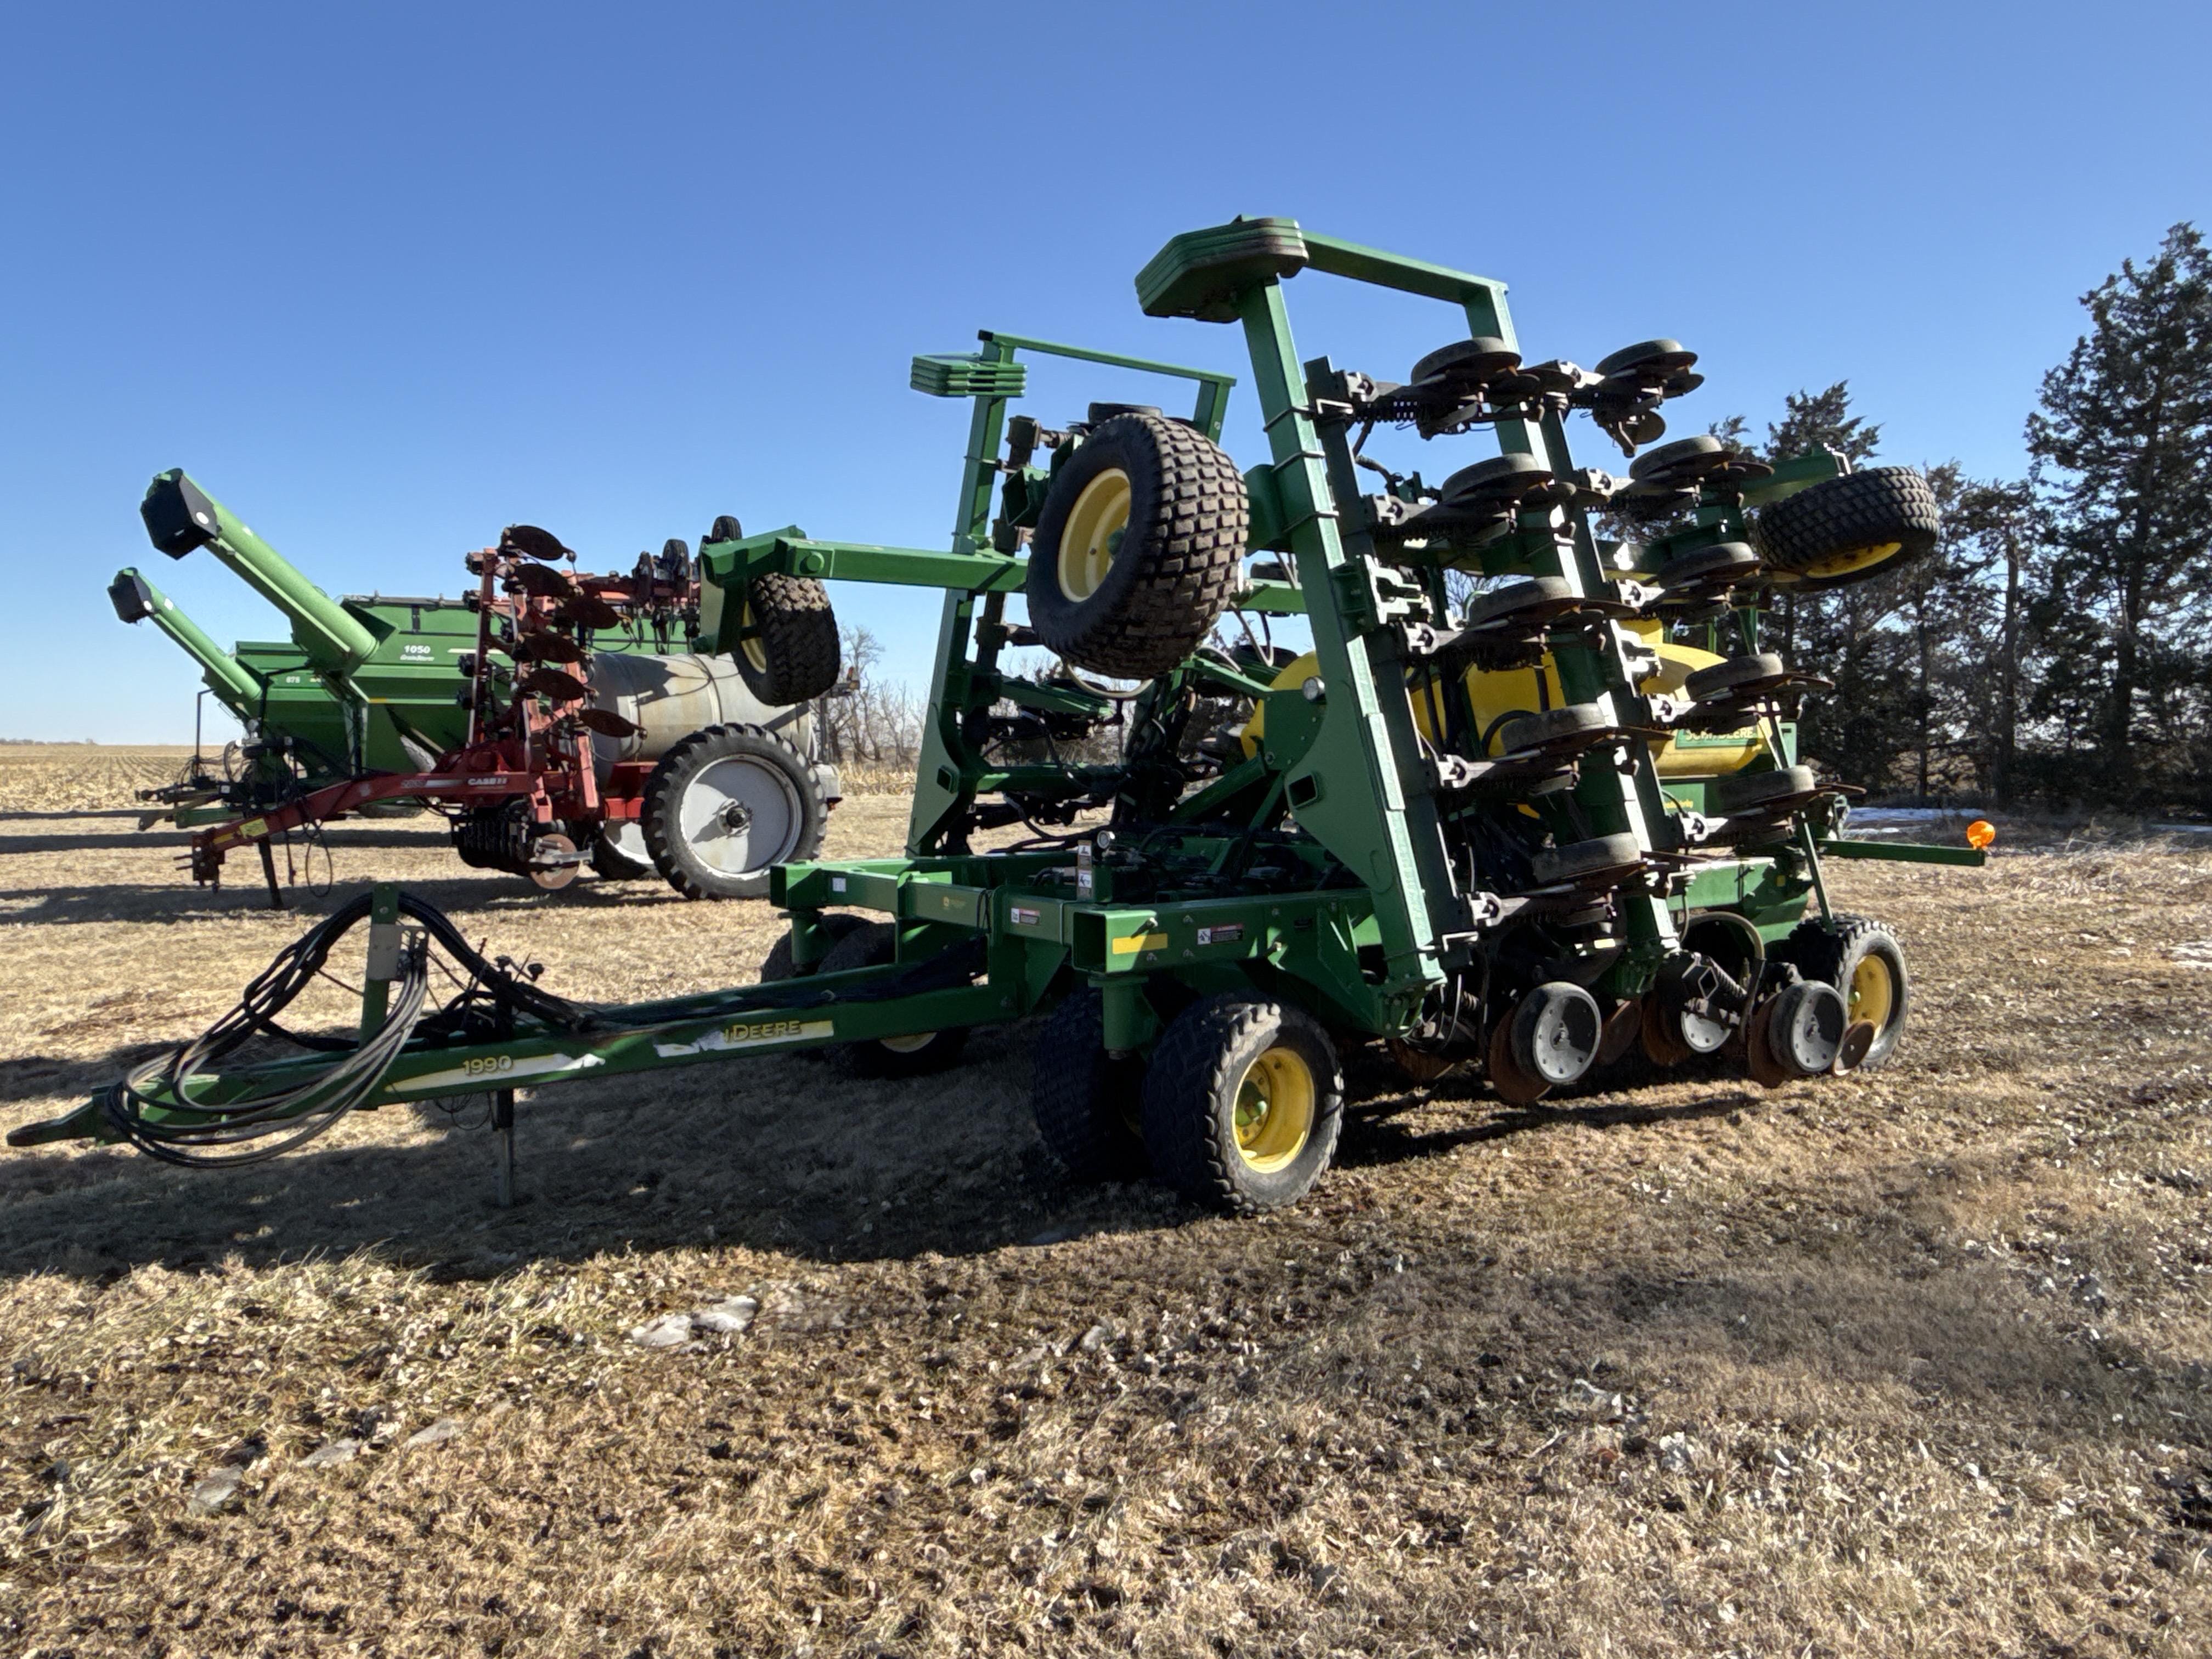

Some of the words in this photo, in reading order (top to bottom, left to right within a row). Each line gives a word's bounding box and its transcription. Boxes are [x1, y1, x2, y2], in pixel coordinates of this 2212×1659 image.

[404, 644, 431, 654] 1050
[732, 1020, 801, 1041] DEERE
[462, 1055, 512, 1075] 1990
